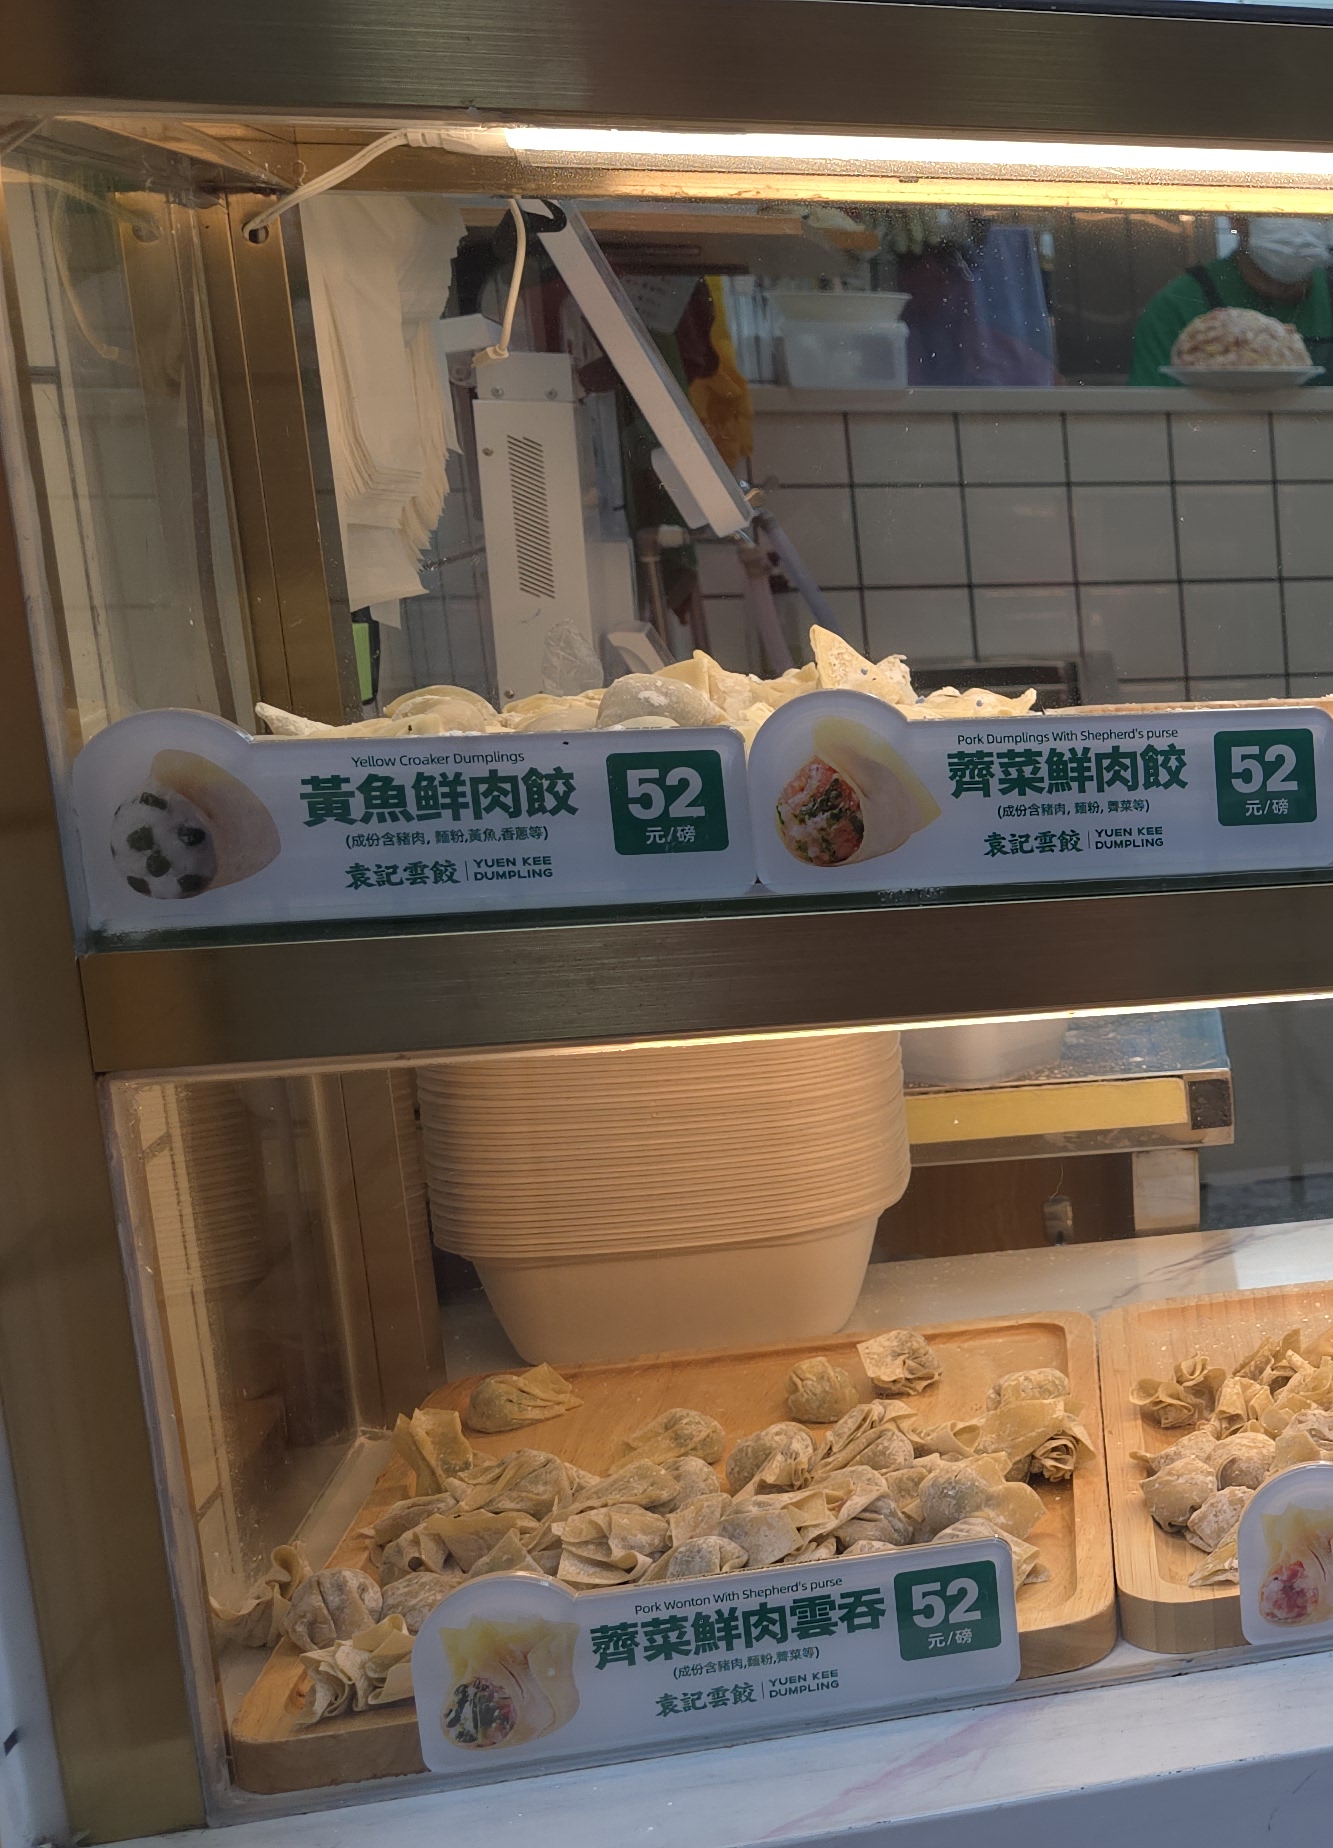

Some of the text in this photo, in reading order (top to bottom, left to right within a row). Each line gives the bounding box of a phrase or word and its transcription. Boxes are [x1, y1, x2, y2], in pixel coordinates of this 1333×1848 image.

[957, 728, 1179, 745] Pork Dumplings With Shepherd's purse
[351, 751, 525, 768] Yellow Croaker Dumplings
[1230, 743, 1299, 794] 52
[947, 743, 1188, 799] 薺菜鮮肉餃
[300, 766, 579, 827] 黃魚鮮肉餃
[627, 766, 706, 820] 52
[1245, 799, 1289, 817] 元/磅
[646, 825, 696, 844] 元/磅
[1095, 826, 1163, 838] YUEN KEE
[983, 829, 1084, 857] 袁記雲餃
[1095, 838, 1164, 850] DUMPLING
[473, 855, 552, 868] YUEN KEE
[345, 860, 461, 890] 袁記雲餃
[474, 867, 553, 881] DUMPLING
[635, 1577, 843, 1615] Pork Wonton With Shepherd's purse
[911, 1577, 981, 1628] 52
[590, 1587, 886, 1670] 薺菜鮮肉雲吞
[928, 1628, 973, 1649] 元/磅
[769, 1669, 839, 1687] YUEN KEE
[769, 1680, 840, 1698] DUMPLING
[655, 1682, 758, 1718] 袁記雲餃
